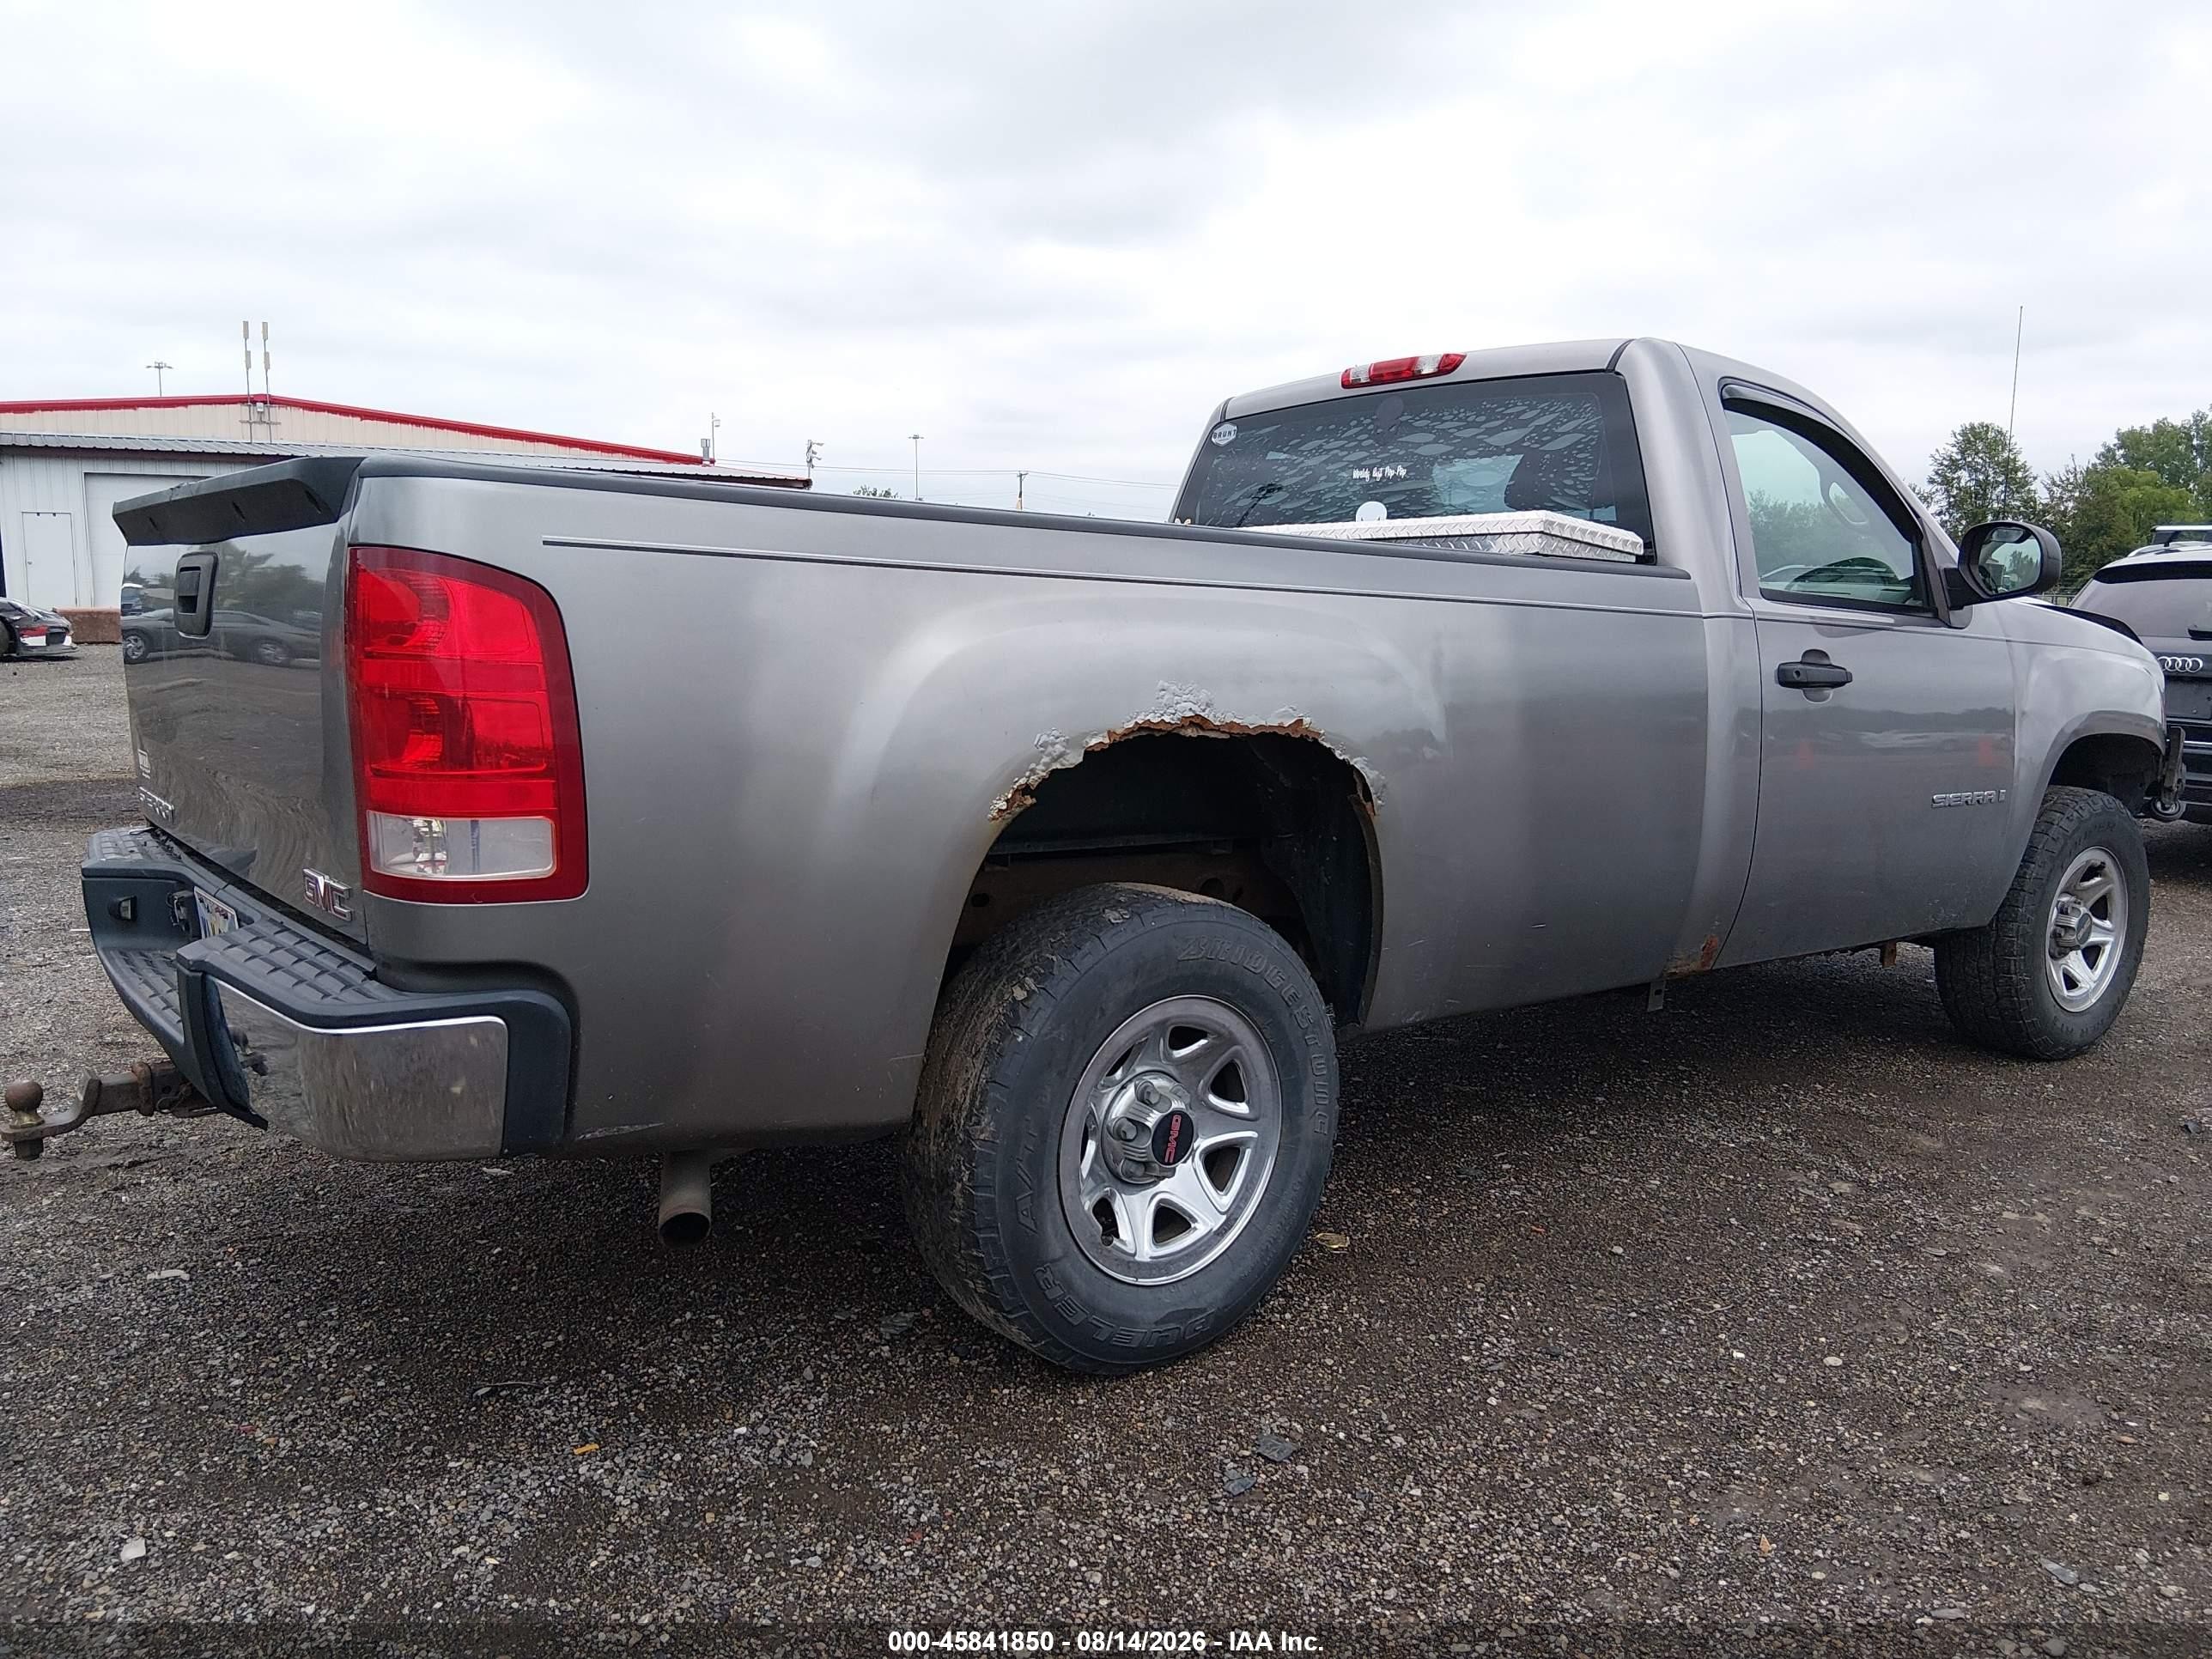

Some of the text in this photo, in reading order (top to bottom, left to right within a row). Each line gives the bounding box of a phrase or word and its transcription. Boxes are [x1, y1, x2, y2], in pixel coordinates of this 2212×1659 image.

[1212, 428, 1237, 440] BRUNT
[1931, 791, 1996, 808] SIERRA
[302, 868, 354, 921] GMC
[1177, 934, 1329, 1136] BRIDGESTONE
[1164, 1114, 1182, 1164] GMC
[1033, 1263, 1218, 1348] DUELER
